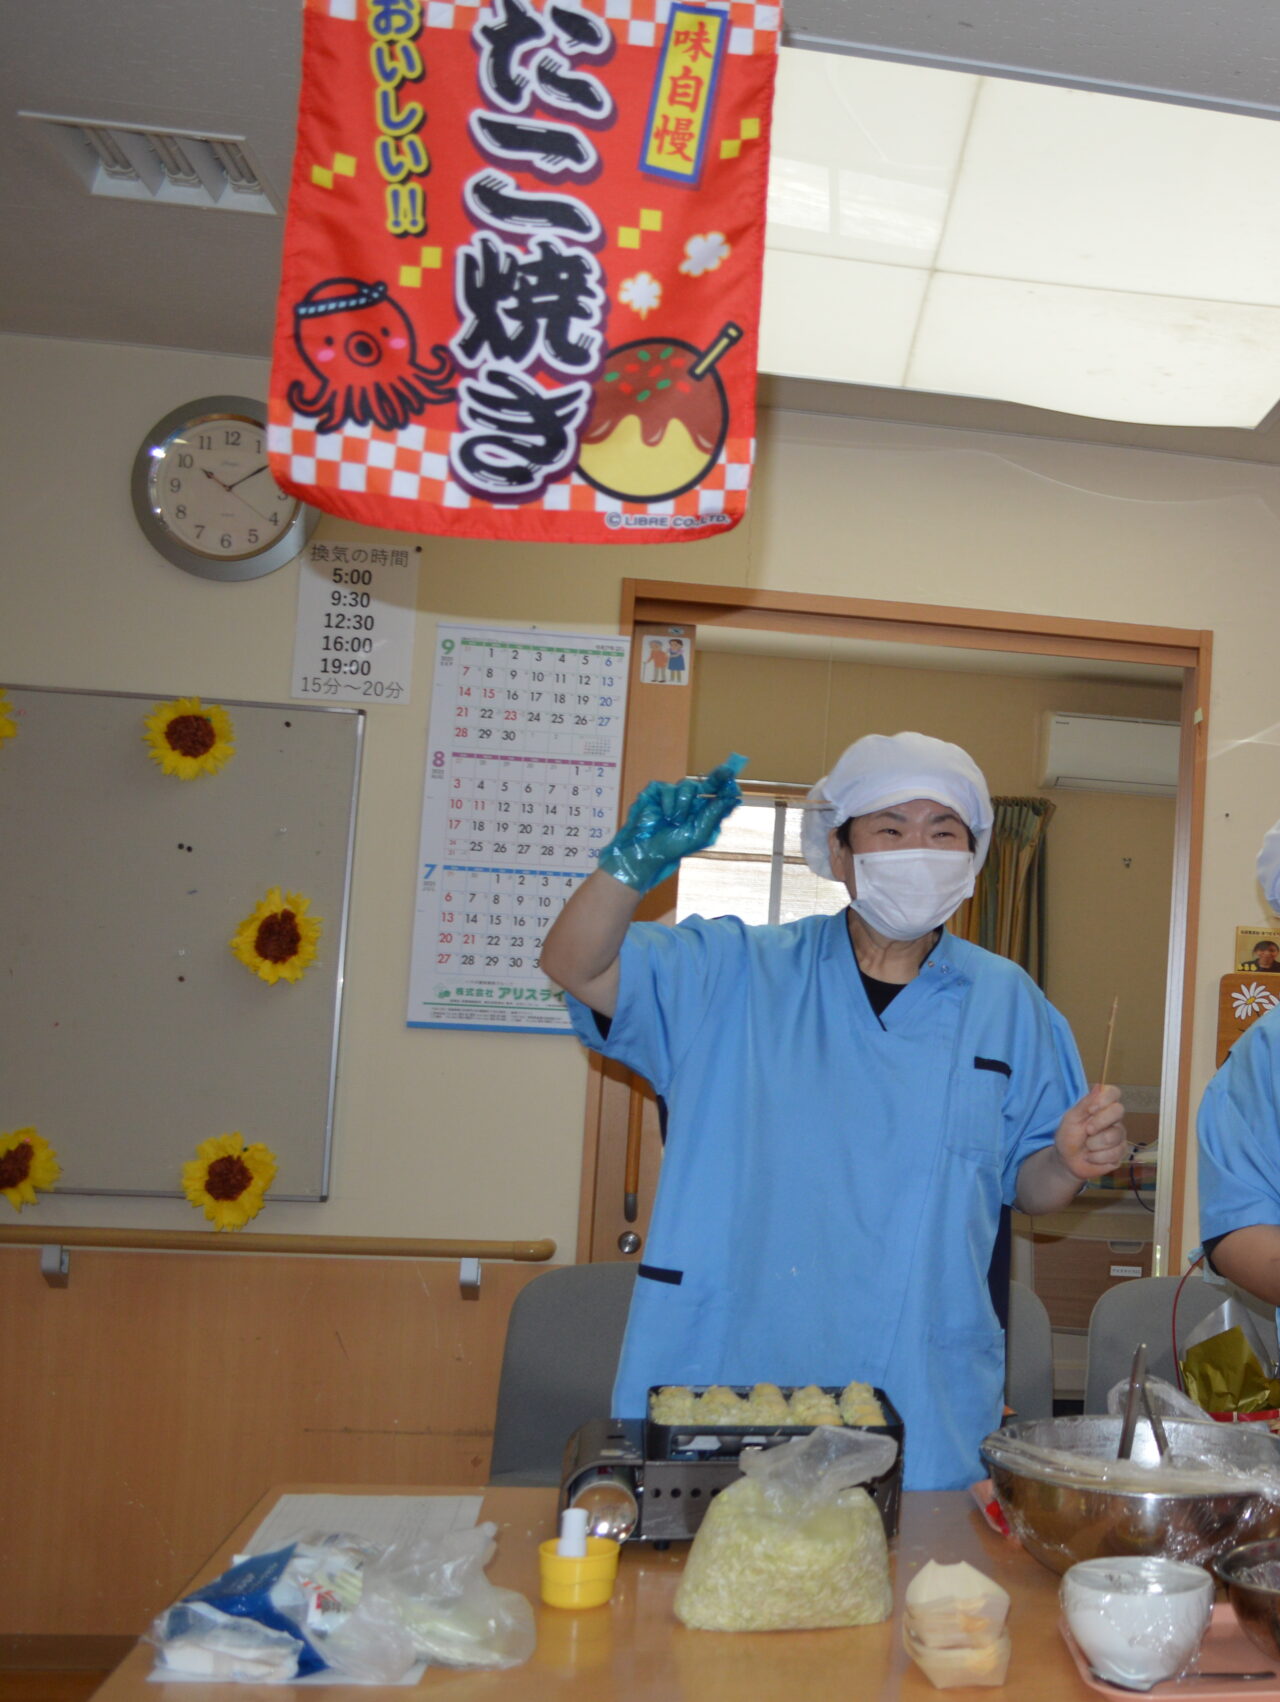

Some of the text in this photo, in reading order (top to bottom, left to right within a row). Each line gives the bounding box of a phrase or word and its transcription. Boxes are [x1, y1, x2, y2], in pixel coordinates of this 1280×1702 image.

[652, 21, 714, 164] 味自慢
[452, 0, 609, 490] たこ焼き
[199, 435, 212, 450] 11
[224, 431, 241, 447] 12
[255, 439, 262, 454] 1
[177, 453, 194, 469] 10
[169, 477, 182, 493] 9
[175, 504, 187, 520] 8
[268, 511, 279, 527] 4
[624, 515, 669, 527] LIBRE
[194, 524, 206, 540] 7
[247, 528, 259, 544] 5
[220, 533, 232, 549] 6
[310, 543, 410, 568] 換気の時間
[332, 567, 373, 586] 5:00
[330, 590, 371, 609] 9:30
[323, 612, 375, 632] 12:30
[321, 635, 374, 654] 16:00
[441, 638, 456, 655] 9
[511, 649, 519, 660] 2
[535, 651, 543, 662] 3
[558, 653, 566, 664] 4
[581, 655, 590, 666] 5
[604, 656, 613, 667] 6
[320, 658, 372, 677] 19:00
[462, 665, 615, 688] 7 8 9 10 11 12 13
[458, 685, 613, 708] 14 15 16 17 18 19 20
[455, 706, 612, 727] 21 22 23 24 25 26 27
[454, 726, 469, 738] 28
[477, 728, 493, 740] 29
[501, 729, 517, 742] 30
[432, 750, 446, 768] 8
[597, 767, 604, 778] 2
[453, 777, 604, 798] 3 4 5 6 7 8 9
[449, 798, 605, 819] 10 11 12 13 14 15 16
[448, 818, 603, 839] 17 18 19 20 21 22 23
[469, 840, 484, 852] 25
[493, 842, 508, 854] 26
[516, 843, 532, 855] 27
[540, 844, 555, 857] 28
[564, 846, 579, 857] 29
[423, 863, 438, 880] 7
[518, 874, 526, 886] 2
[541, 876, 549, 887] 3
[565, 877, 573, 887] 4
[444, 891, 453, 903] 6
[468, 892, 477, 903] 7
[492, 893, 501, 905] 8
[516, 895, 525, 906] 9
[537, 896, 552, 908] 10
[441, 911, 550, 928] 13 14 15 16 17
[438, 932, 453, 944] 20
[462, 933, 476, 945] 21
[486, 934, 501, 947] 22
[509, 935, 525, 948] 23
[436, 952, 452, 965] 27
[460, 954, 475, 966] 28
[484, 955, 500, 967] 29
[508, 956, 524, 968] 30
[456, 986, 494, 998] 株式会社
